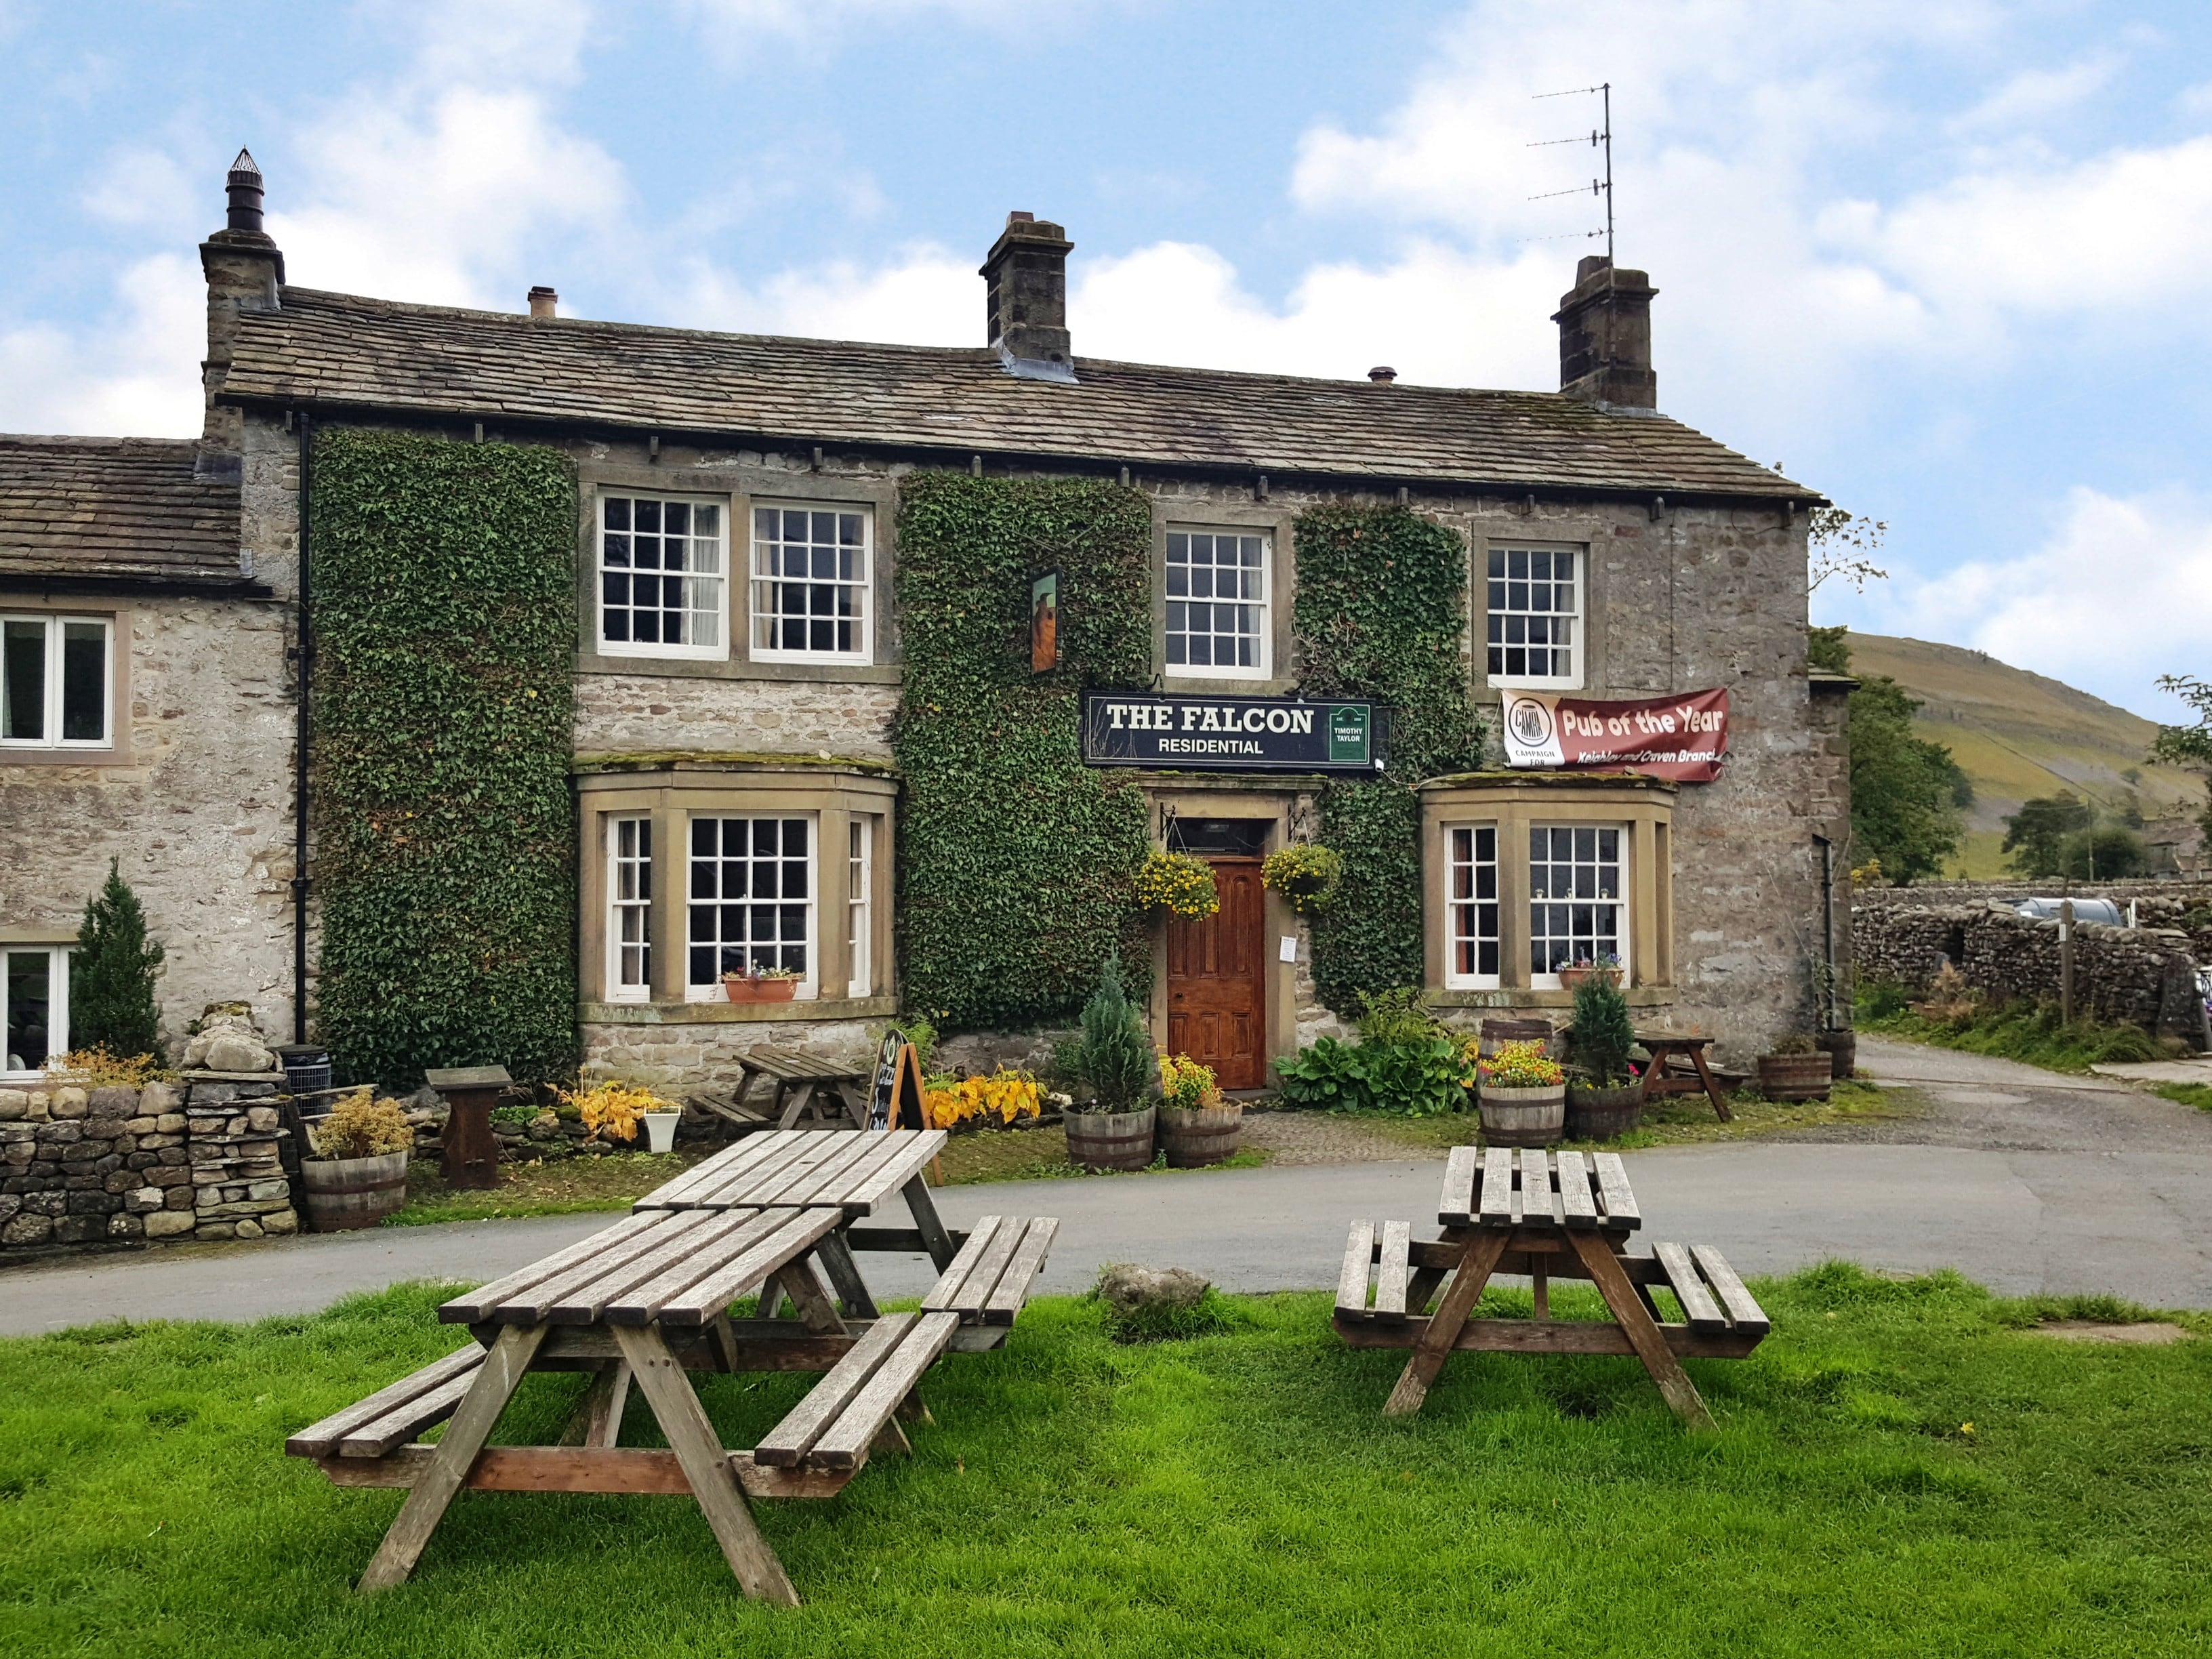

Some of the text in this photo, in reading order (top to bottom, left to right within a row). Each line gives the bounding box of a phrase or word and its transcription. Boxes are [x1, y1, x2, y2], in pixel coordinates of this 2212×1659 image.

[1107, 704, 1314, 733] THE FALCON
[1515, 710, 1543, 738] CAMRA
[1563, 705, 1723, 737] Pub of the Year
[1159, 738, 1264, 754] RESIDENTIAL
[1515, 750, 1555, 758] CAMPAIGN
[1530, 758, 1545, 766] FOR
[1577, 750, 1622, 764] Keighley
[1620, 750, 1643, 762] and
[1641, 750, 1676, 762] Craven
[877, 1062, 896, 1086] PIZZ
